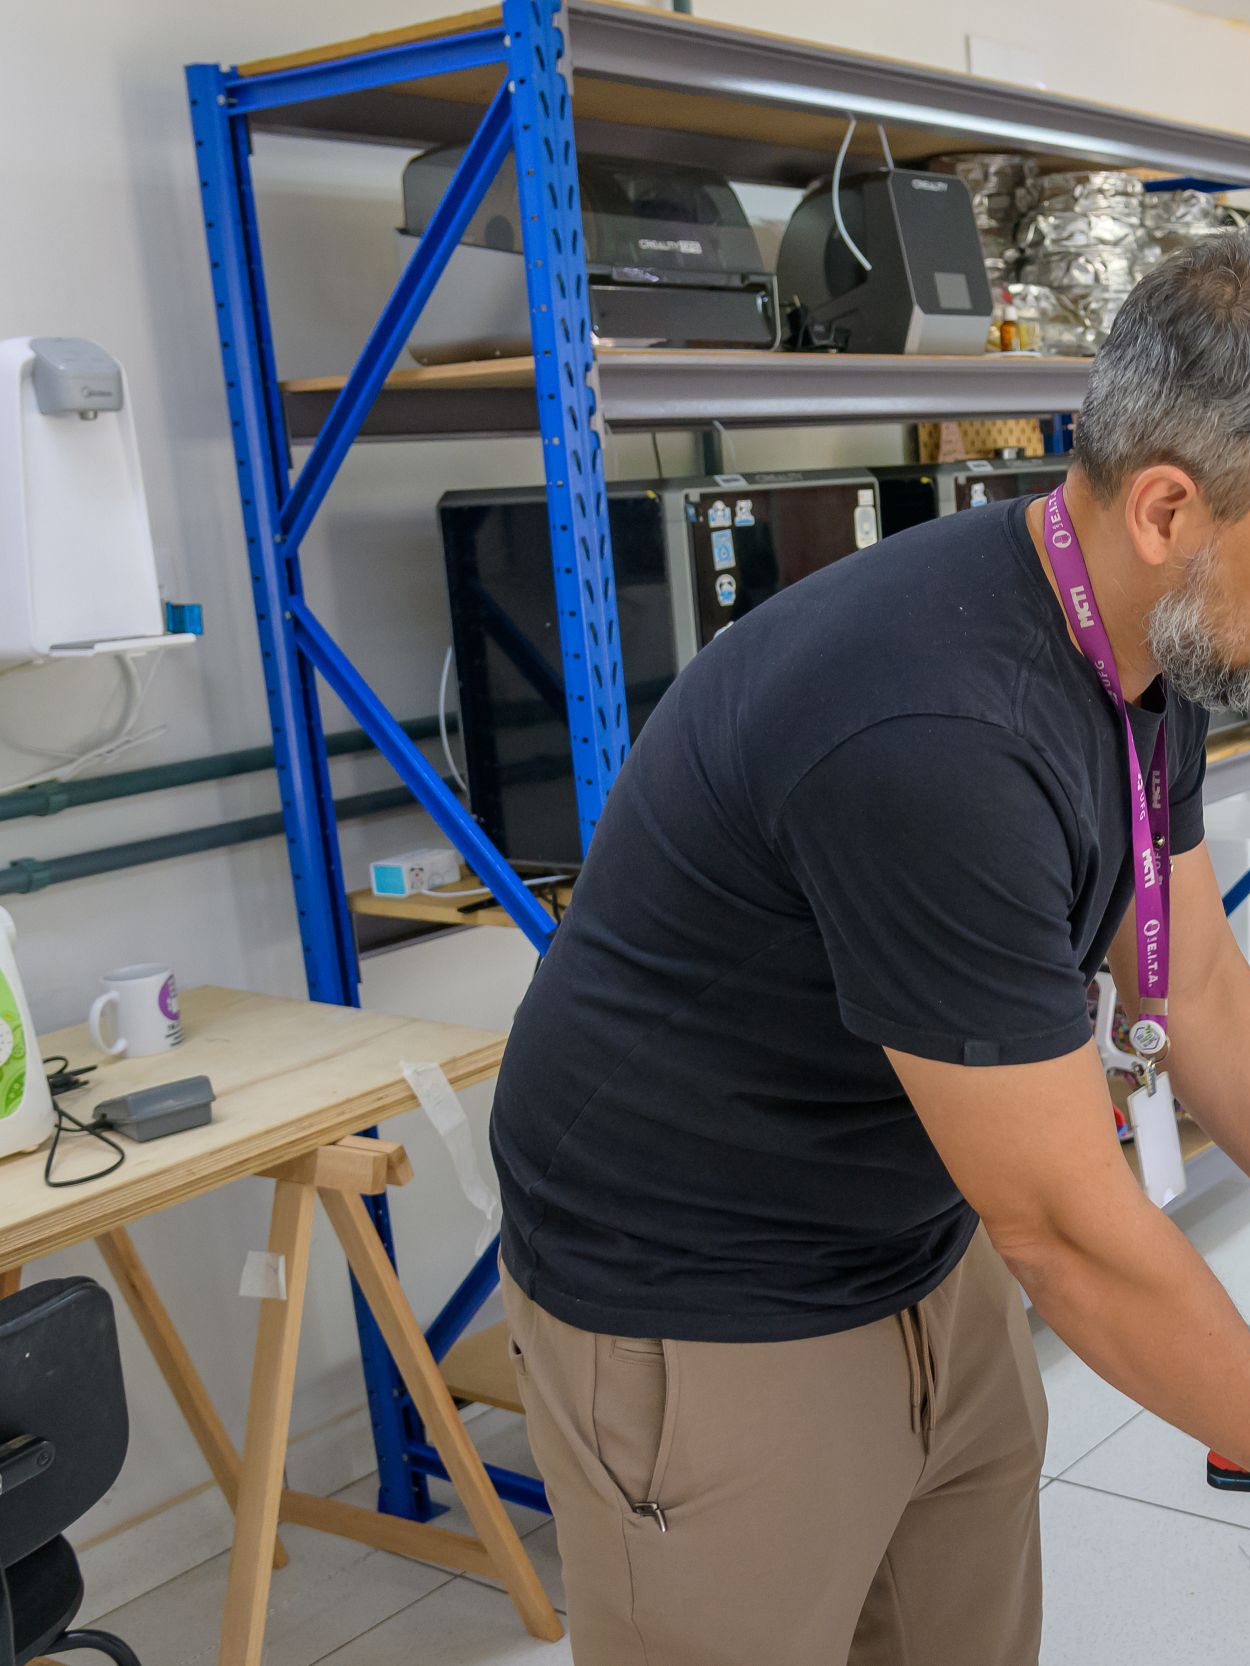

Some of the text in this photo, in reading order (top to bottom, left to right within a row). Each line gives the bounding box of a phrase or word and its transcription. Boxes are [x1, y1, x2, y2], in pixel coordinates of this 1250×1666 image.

[1070, 585, 1095, 628] MCTI
[1095, 660, 1111, 687] UFG
[1152, 770, 1161, 809] MCTI
[1142, 848, 1155, 888] MCTI
[1147, 943, 1159, 988] E.I.T.A.
